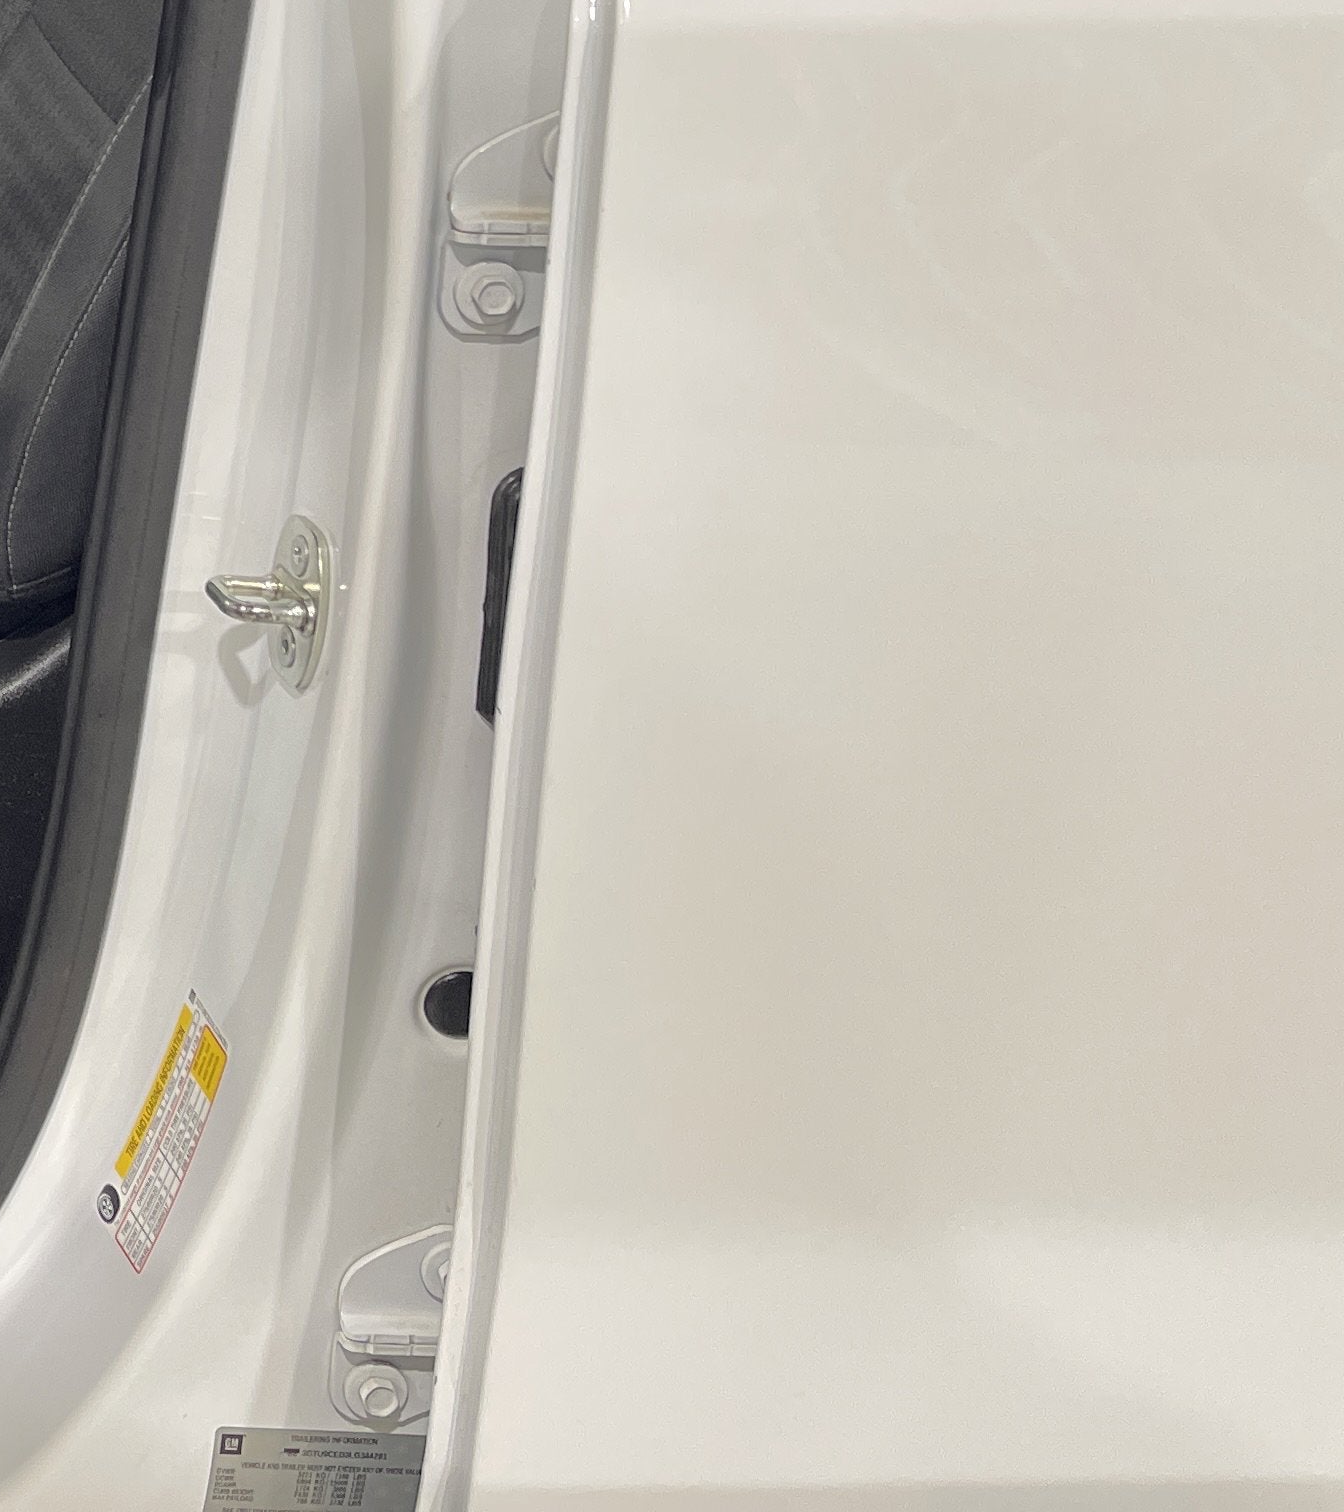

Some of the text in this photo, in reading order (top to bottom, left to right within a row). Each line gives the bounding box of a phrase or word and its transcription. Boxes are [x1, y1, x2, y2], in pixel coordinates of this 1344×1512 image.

[125, 1136, 138, 1159] TIRE
[141, 1081, 163, 1122] LOADING
[158, 1024, 186, 1084] INFORMATION
